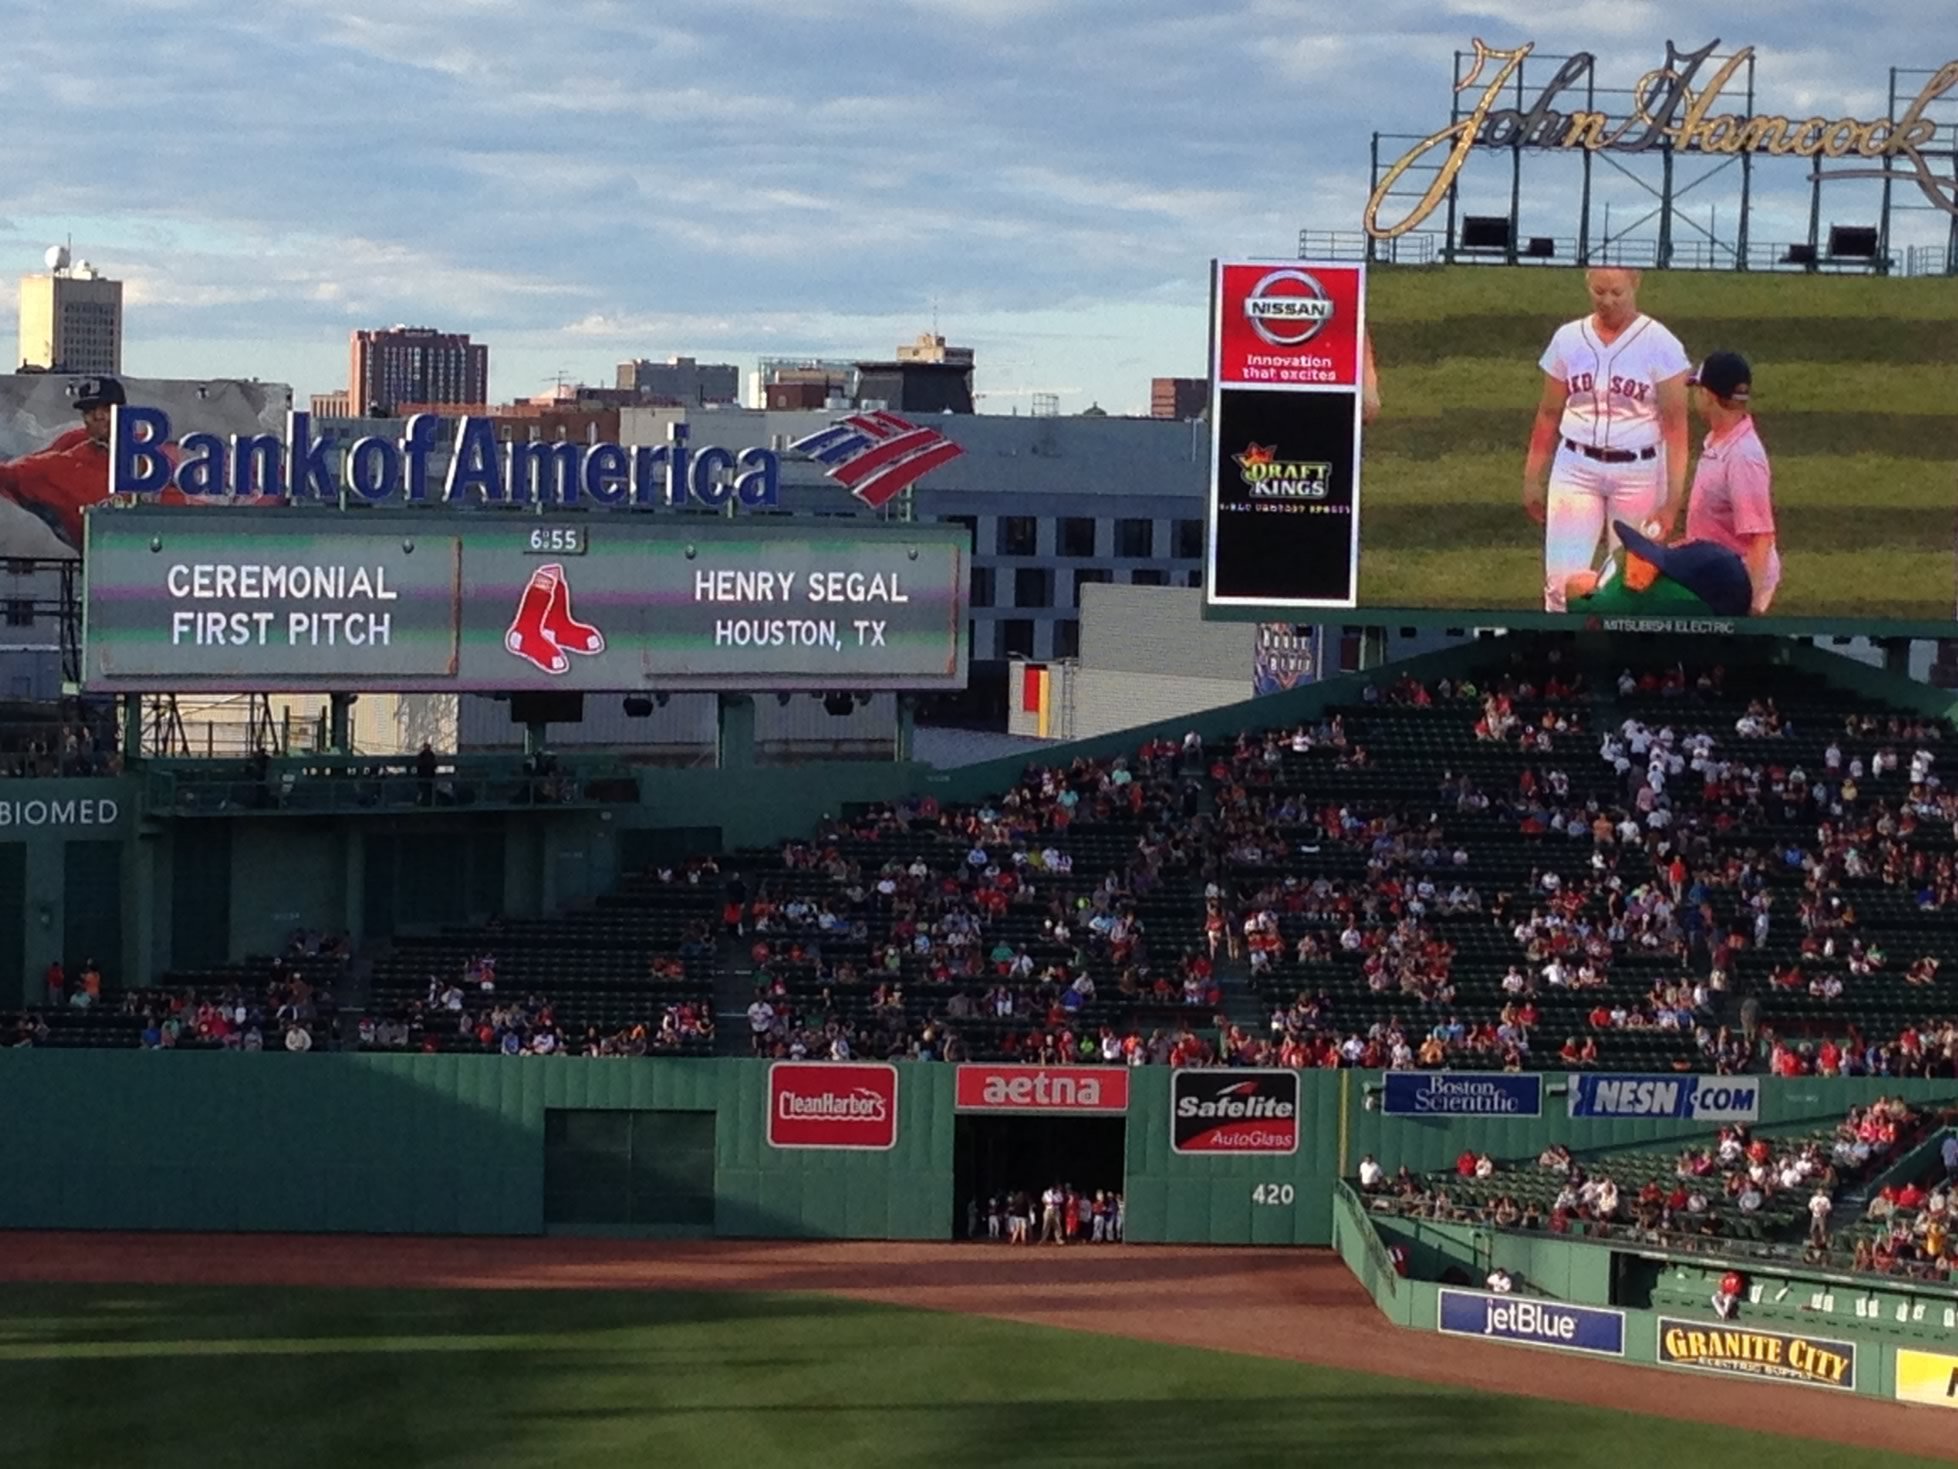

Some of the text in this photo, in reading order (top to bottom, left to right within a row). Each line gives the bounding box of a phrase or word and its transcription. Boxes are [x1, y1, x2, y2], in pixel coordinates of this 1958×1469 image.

[1364, 37, 1958, 239] John Hancock
[1252, 301, 1326, 316] NISSAN
[1247, 355, 1332, 368] Innovation
[1243, 368, 1337, 381] that excites
[1610, 376, 1650, 402] SOX
[109, 404, 781, 507] Bank of America
[1244, 464, 1328, 481] DRAFT
[1254, 480, 1325, 496] KINGS
[531, 529, 577, 550] 6:55
[167, 564, 398, 599] CEREMONIAL
[694, 570, 908, 603] HENRY SEGAL
[172, 612, 391, 646] FIRST PITCH
[715, 619, 886, 653] HOUSTON, TX
[1603, 619, 1736, 634] MITSUBISHI ELECTRIC
[0, 799, 118, 825] BIOMED
[983, 1071, 1100, 1105] aetna
[1430, 1075, 1495, 1096] Boston
[1177, 1096, 1294, 1117] Safelite
[1414, 1088, 1519, 1113] Scientific
[1210, 1130, 1294, 1147] AutoGlass
[1252, 1184, 1294, 1204] 420
[1484, 1298, 1576, 1338] jetBlue
[1665, 1327, 1849, 1381] GRANITE CITY
